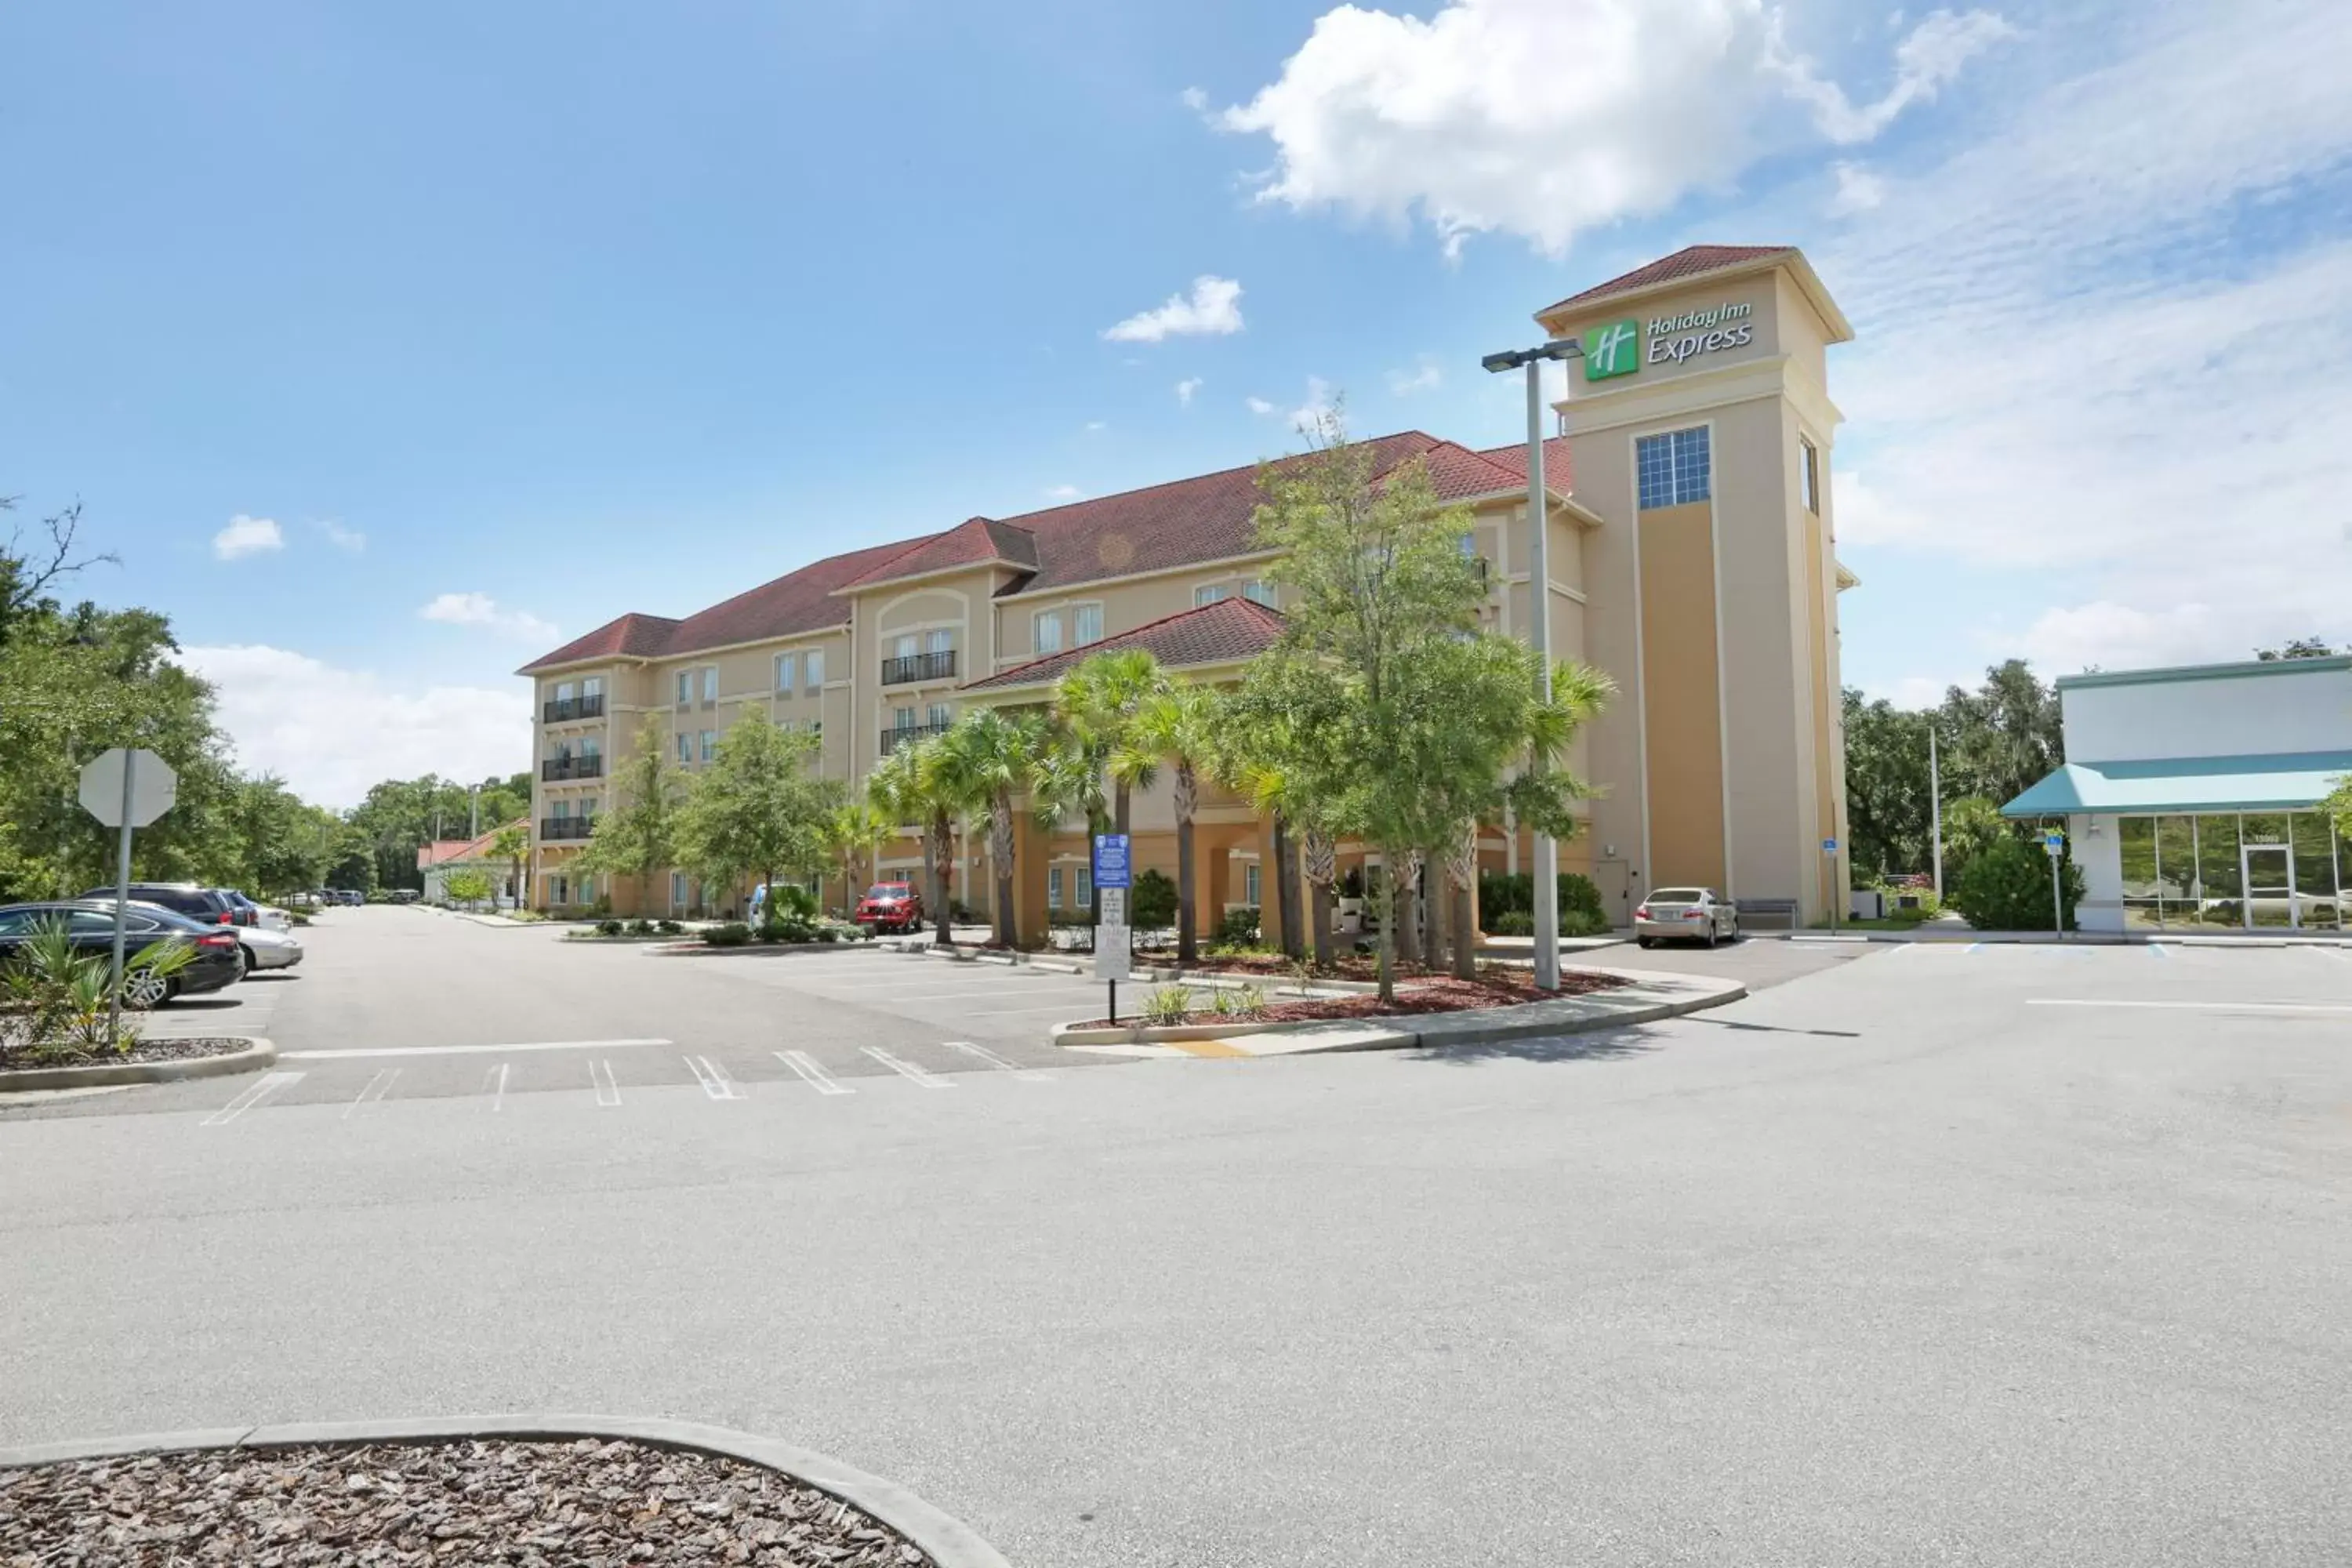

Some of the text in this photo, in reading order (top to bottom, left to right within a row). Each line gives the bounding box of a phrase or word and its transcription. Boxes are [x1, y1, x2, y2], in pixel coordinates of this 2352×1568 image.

[1647, 302, 1751, 336] Holiday Inn
[1648, 324, 1752, 365] Express
